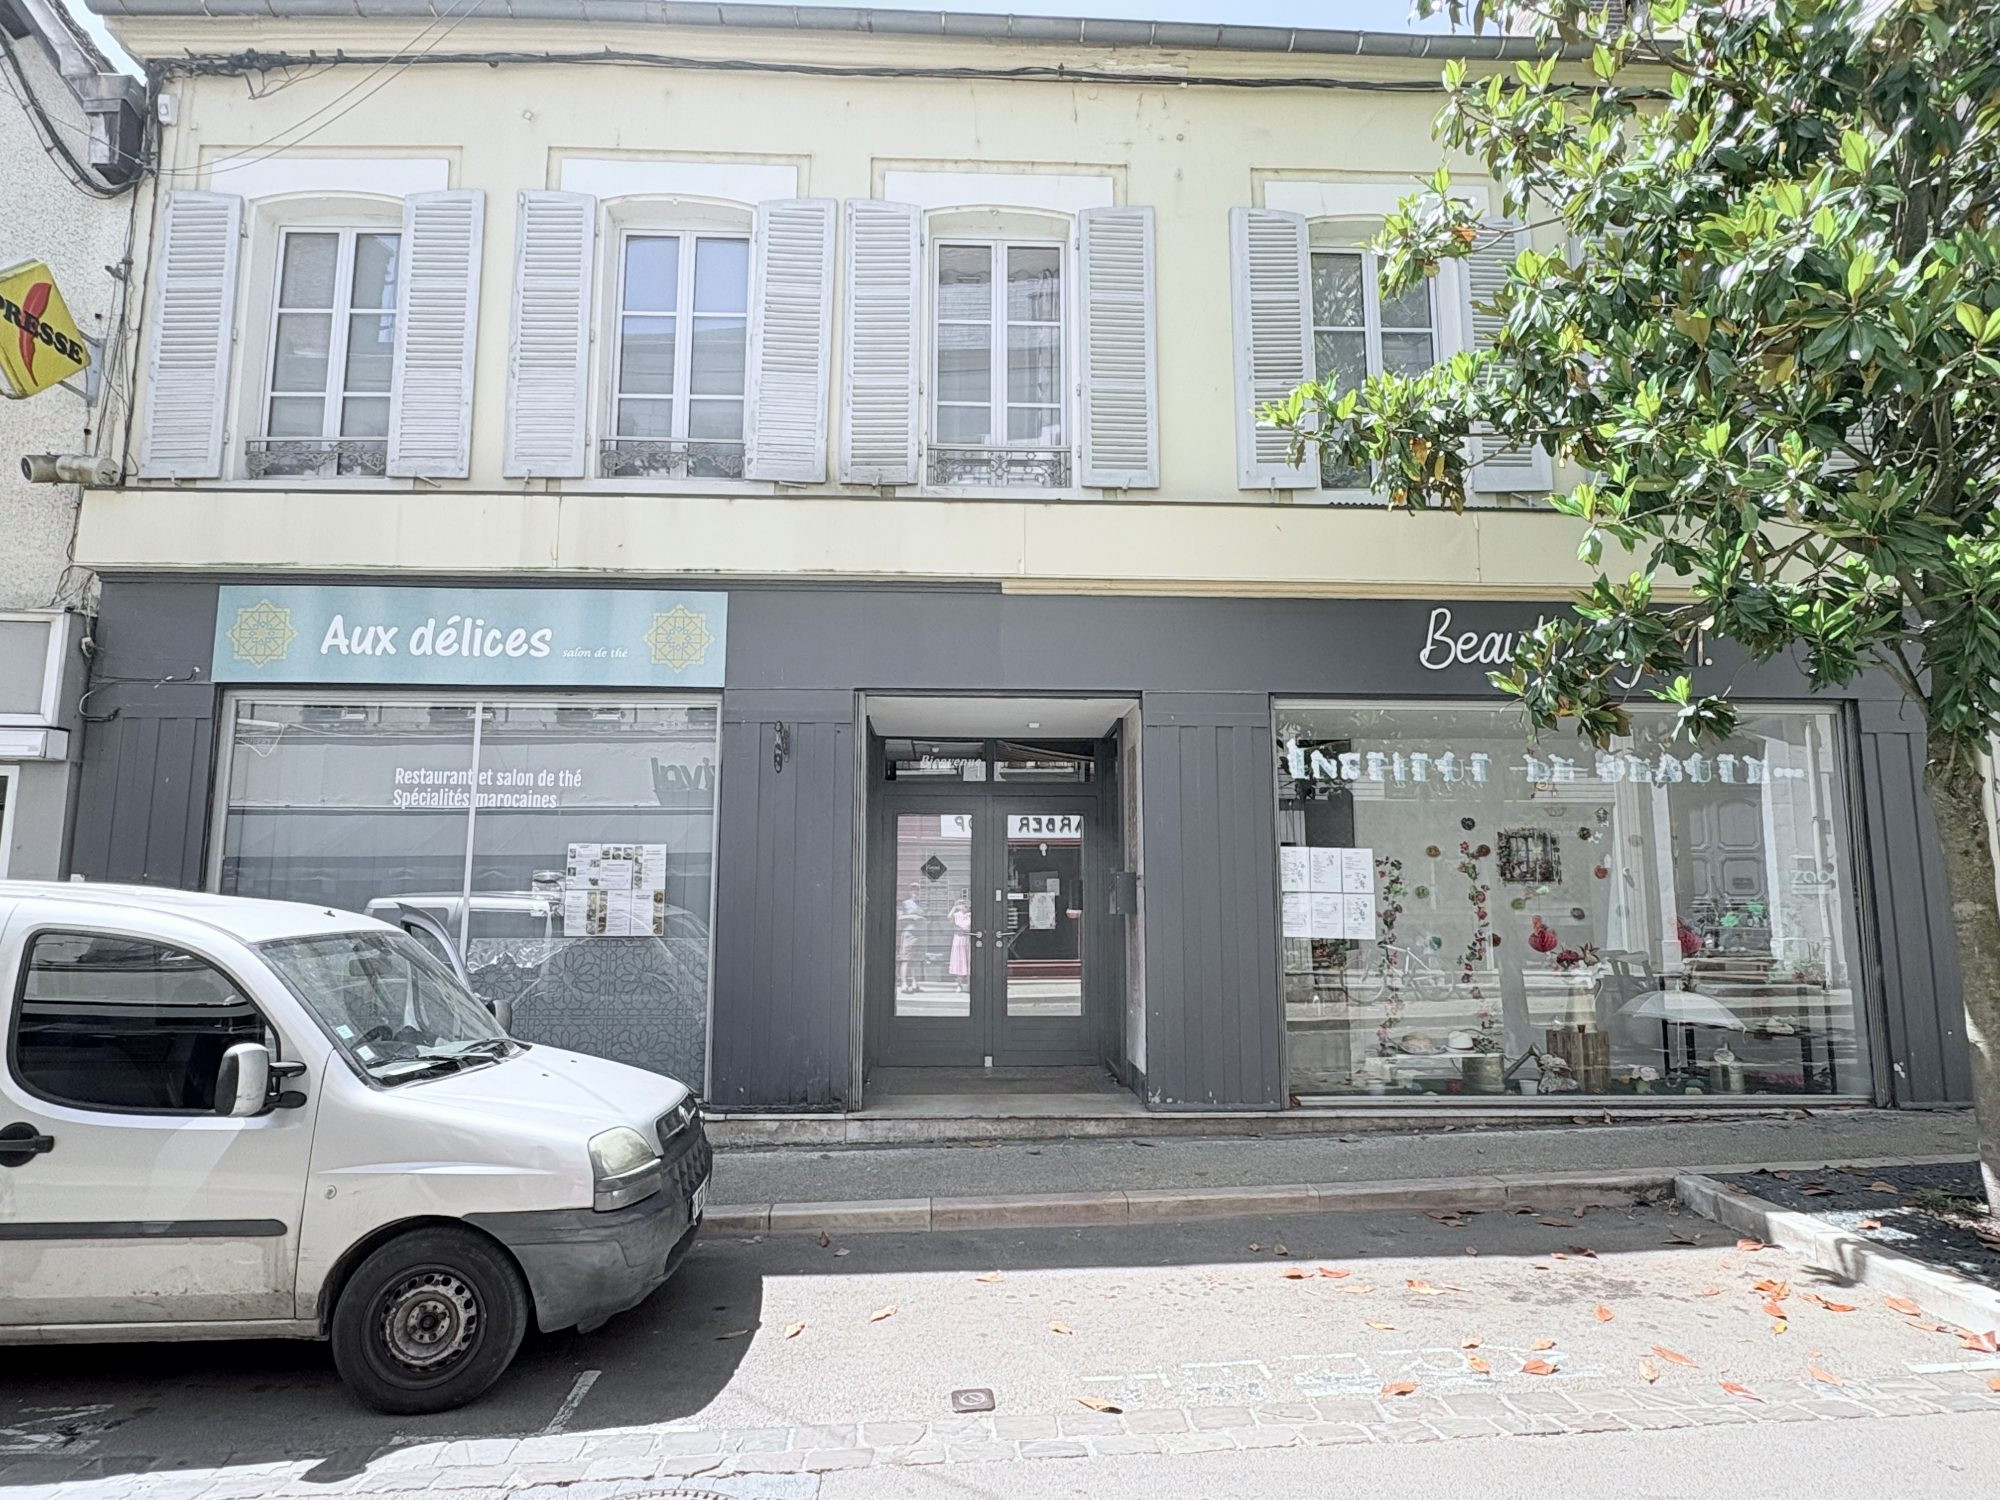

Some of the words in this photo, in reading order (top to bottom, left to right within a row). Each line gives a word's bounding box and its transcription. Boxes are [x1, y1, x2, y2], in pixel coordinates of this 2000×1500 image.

[320, 614, 398, 656] Aux
[409, 615, 553, 658] délices
[562, 646, 591, 658] salon
[594, 646, 608, 658] de
[610, 647, 629, 658] thé
[395, 767, 474, 786] Restaurant
[478, 769, 493, 786] et
[496, 768, 534, 787] salon
[538, 769, 555, 787] de
[559, 769, 582, 788] thé
[393, 787, 470, 809] Spécialités
[475, 790, 557, 809] marocaines
